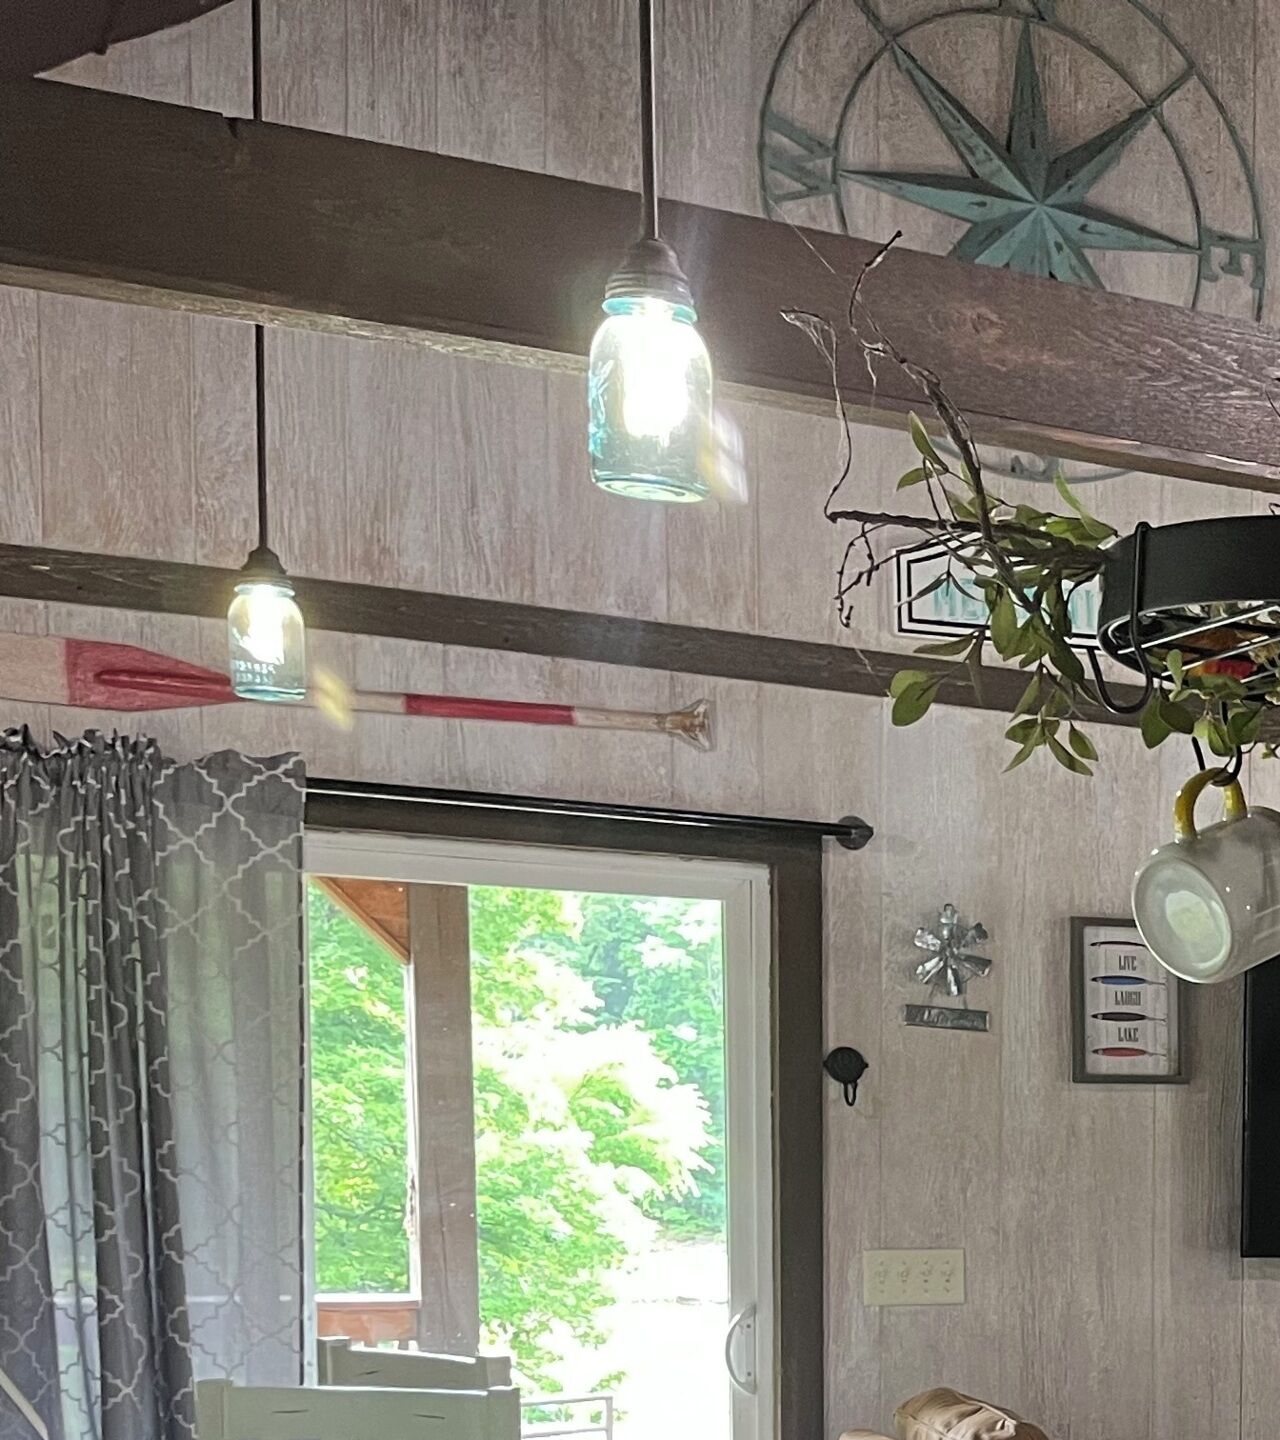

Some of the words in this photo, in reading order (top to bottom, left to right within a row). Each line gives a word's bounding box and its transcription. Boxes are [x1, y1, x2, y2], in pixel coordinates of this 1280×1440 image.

[1199, 226, 1266, 290] E
[1119, 956, 1136, 970] LIVE
[1117, 1027, 1139, 1042] LAKE
